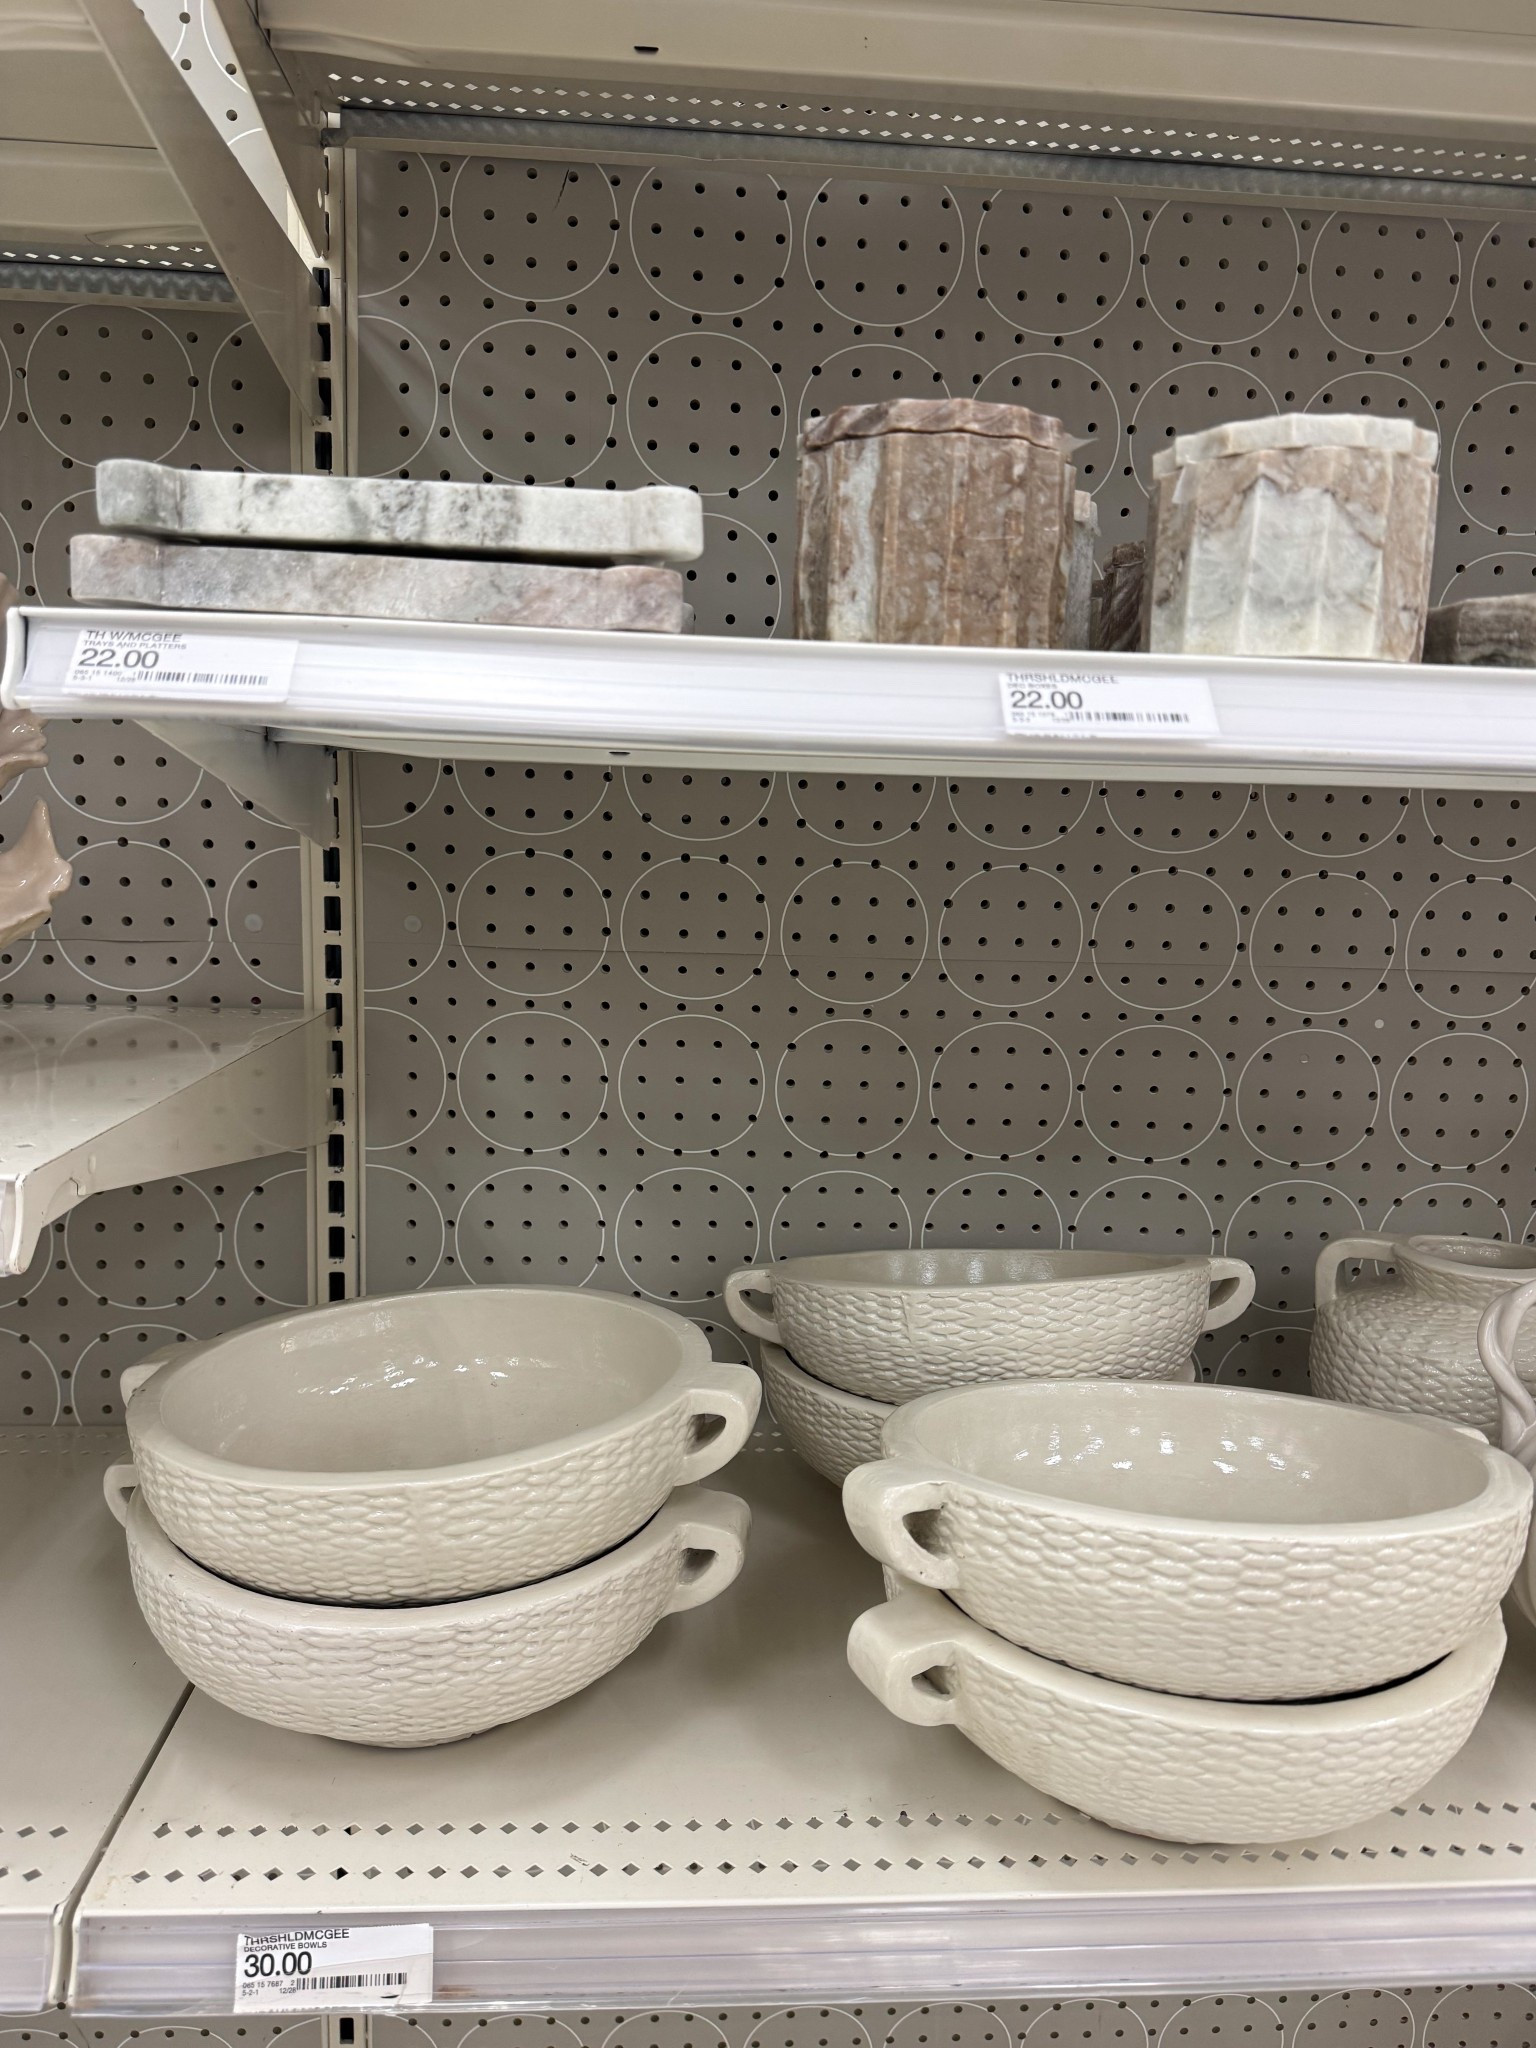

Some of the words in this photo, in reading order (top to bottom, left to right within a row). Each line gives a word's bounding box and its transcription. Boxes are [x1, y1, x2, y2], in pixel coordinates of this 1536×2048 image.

[87, 630, 106, 640] TH
[110, 631, 183, 643] W/MCGEE
[139, 642, 187, 650] PLATTERS
[78, 648, 160, 669] 22.00
[1011, 690, 1083, 710] 22.00
[244, 1929, 350, 1946] THRSHLDMCGEE
[244, 1943, 296, 1953] DECORATIVE
[298, 1941, 328, 1949] BOWLS
[244, 1951, 312, 1978] 30.00
[267, 1980, 283, 1988] 7687
